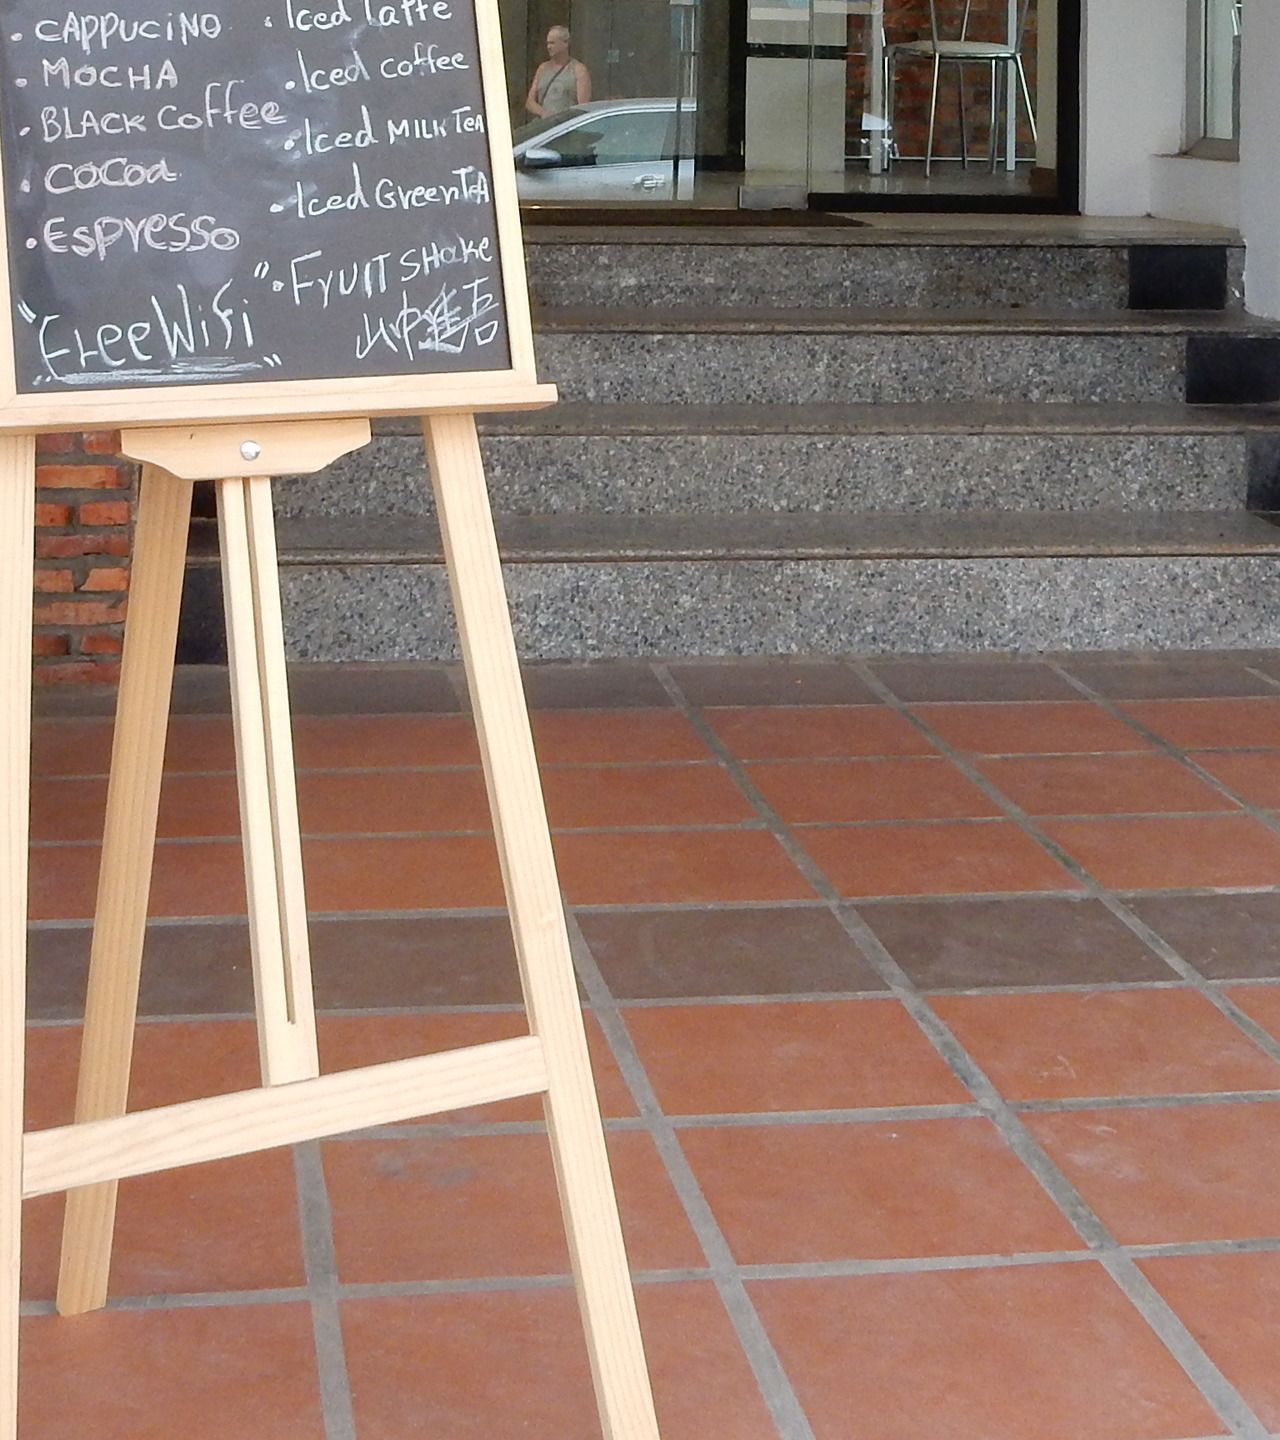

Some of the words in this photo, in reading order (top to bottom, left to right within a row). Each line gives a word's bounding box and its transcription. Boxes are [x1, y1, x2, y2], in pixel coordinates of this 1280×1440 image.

[42, 57, 178, 89] MOCHA
[296, 48, 370, 94] Iced
[41, 106, 147, 143] BLACK
[304, 105, 379, 155] Iced
[296, 161, 370, 219] Iced
